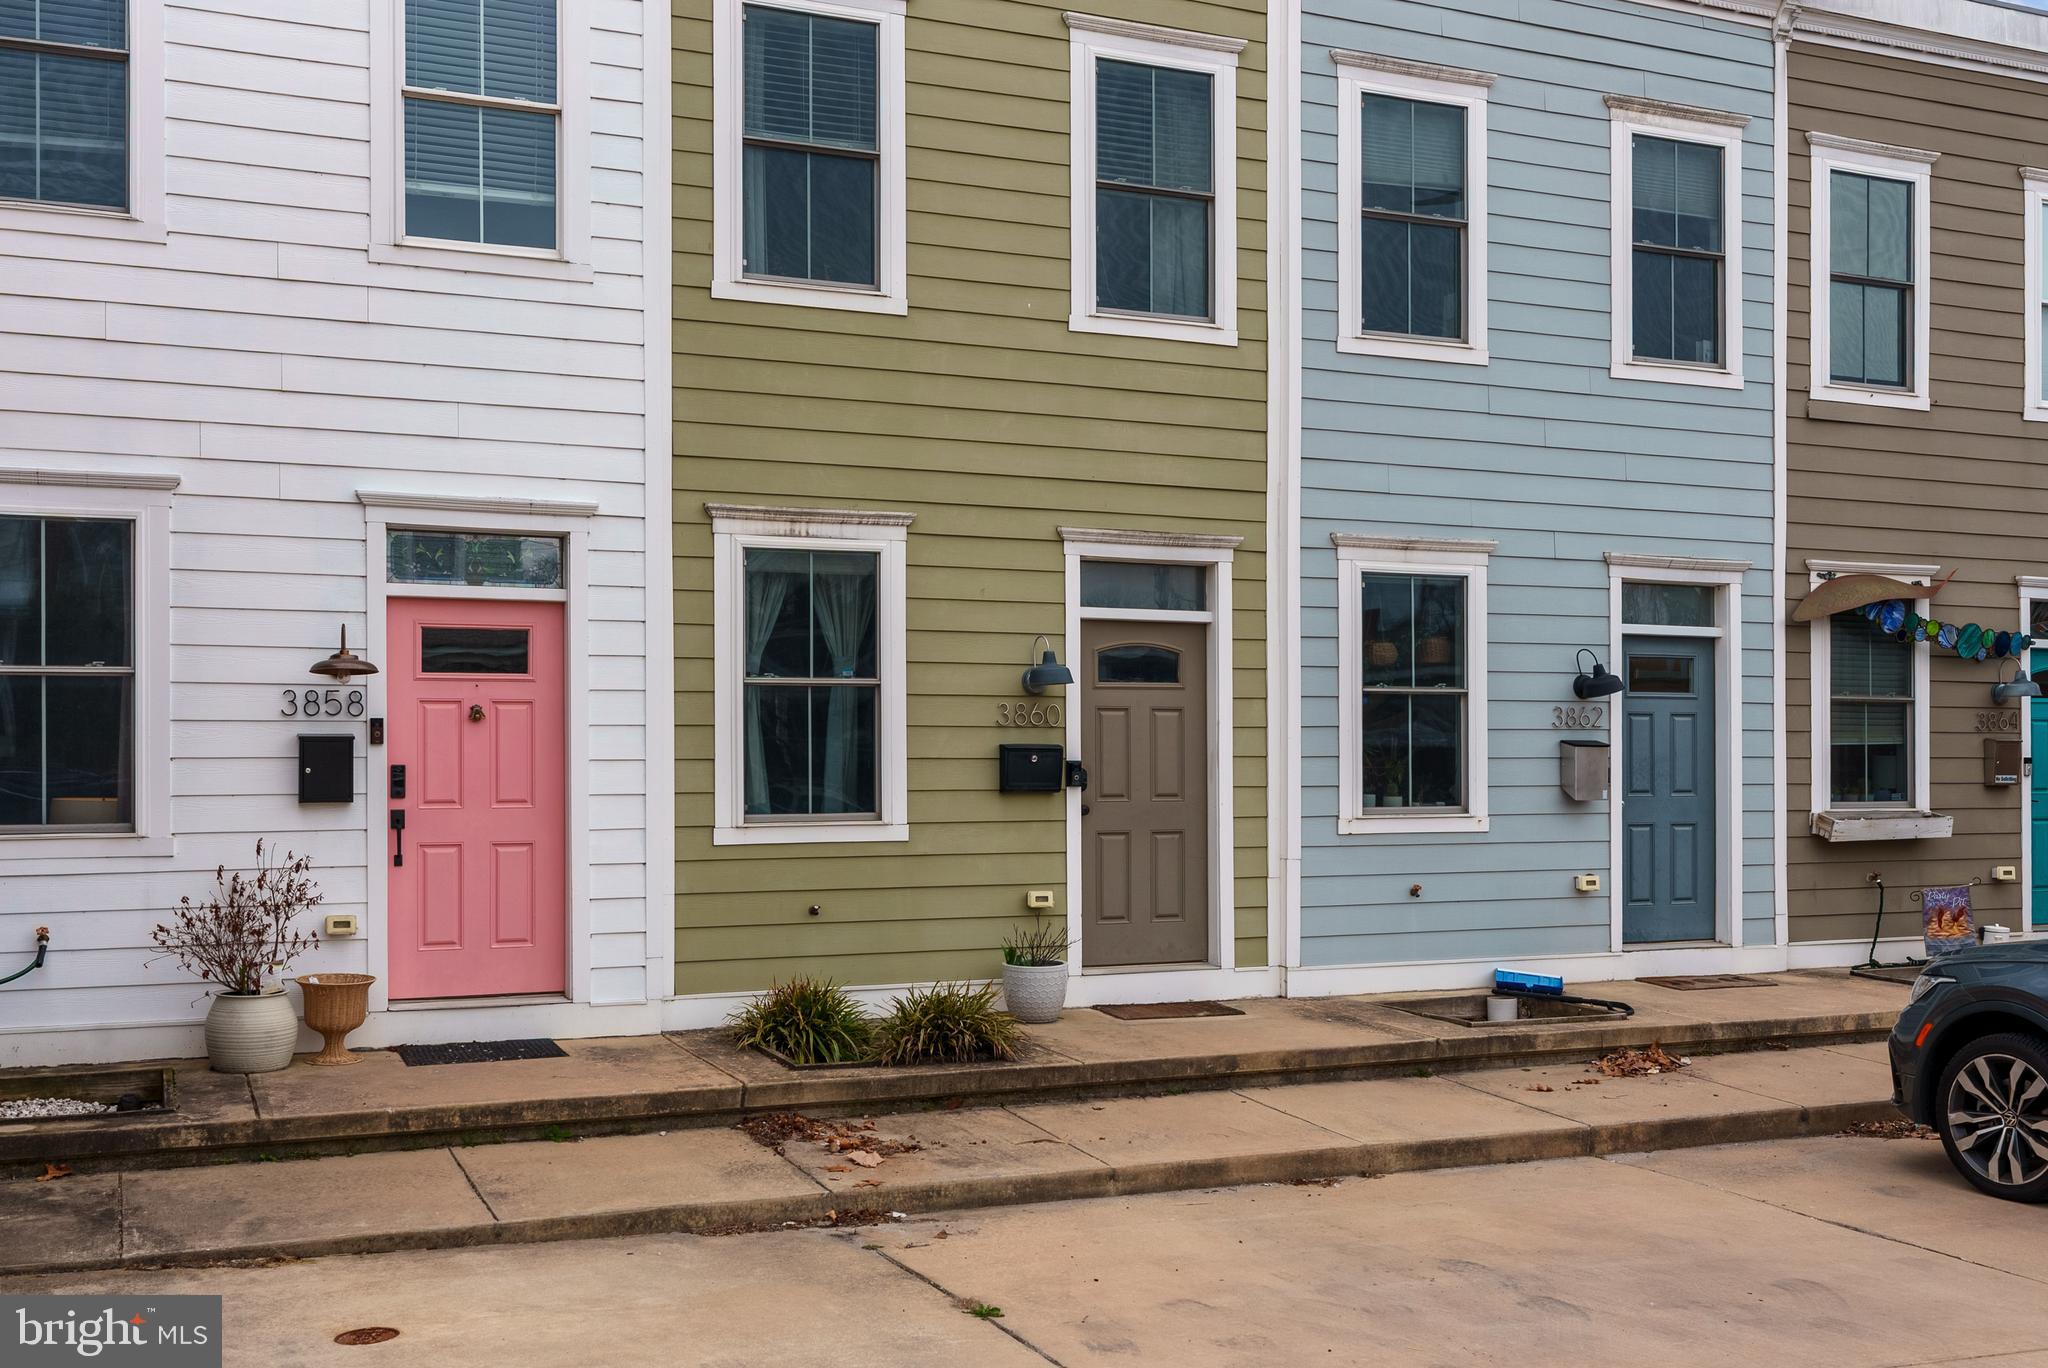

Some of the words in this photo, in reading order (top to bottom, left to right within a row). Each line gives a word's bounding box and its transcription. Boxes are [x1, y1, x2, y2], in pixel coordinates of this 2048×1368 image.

[281, 689, 364, 717] 3858
[996, 702, 1062, 727] 3860
[1552, 705, 1604, 728] 3862
[1975, 711, 2018, 731] 3864
